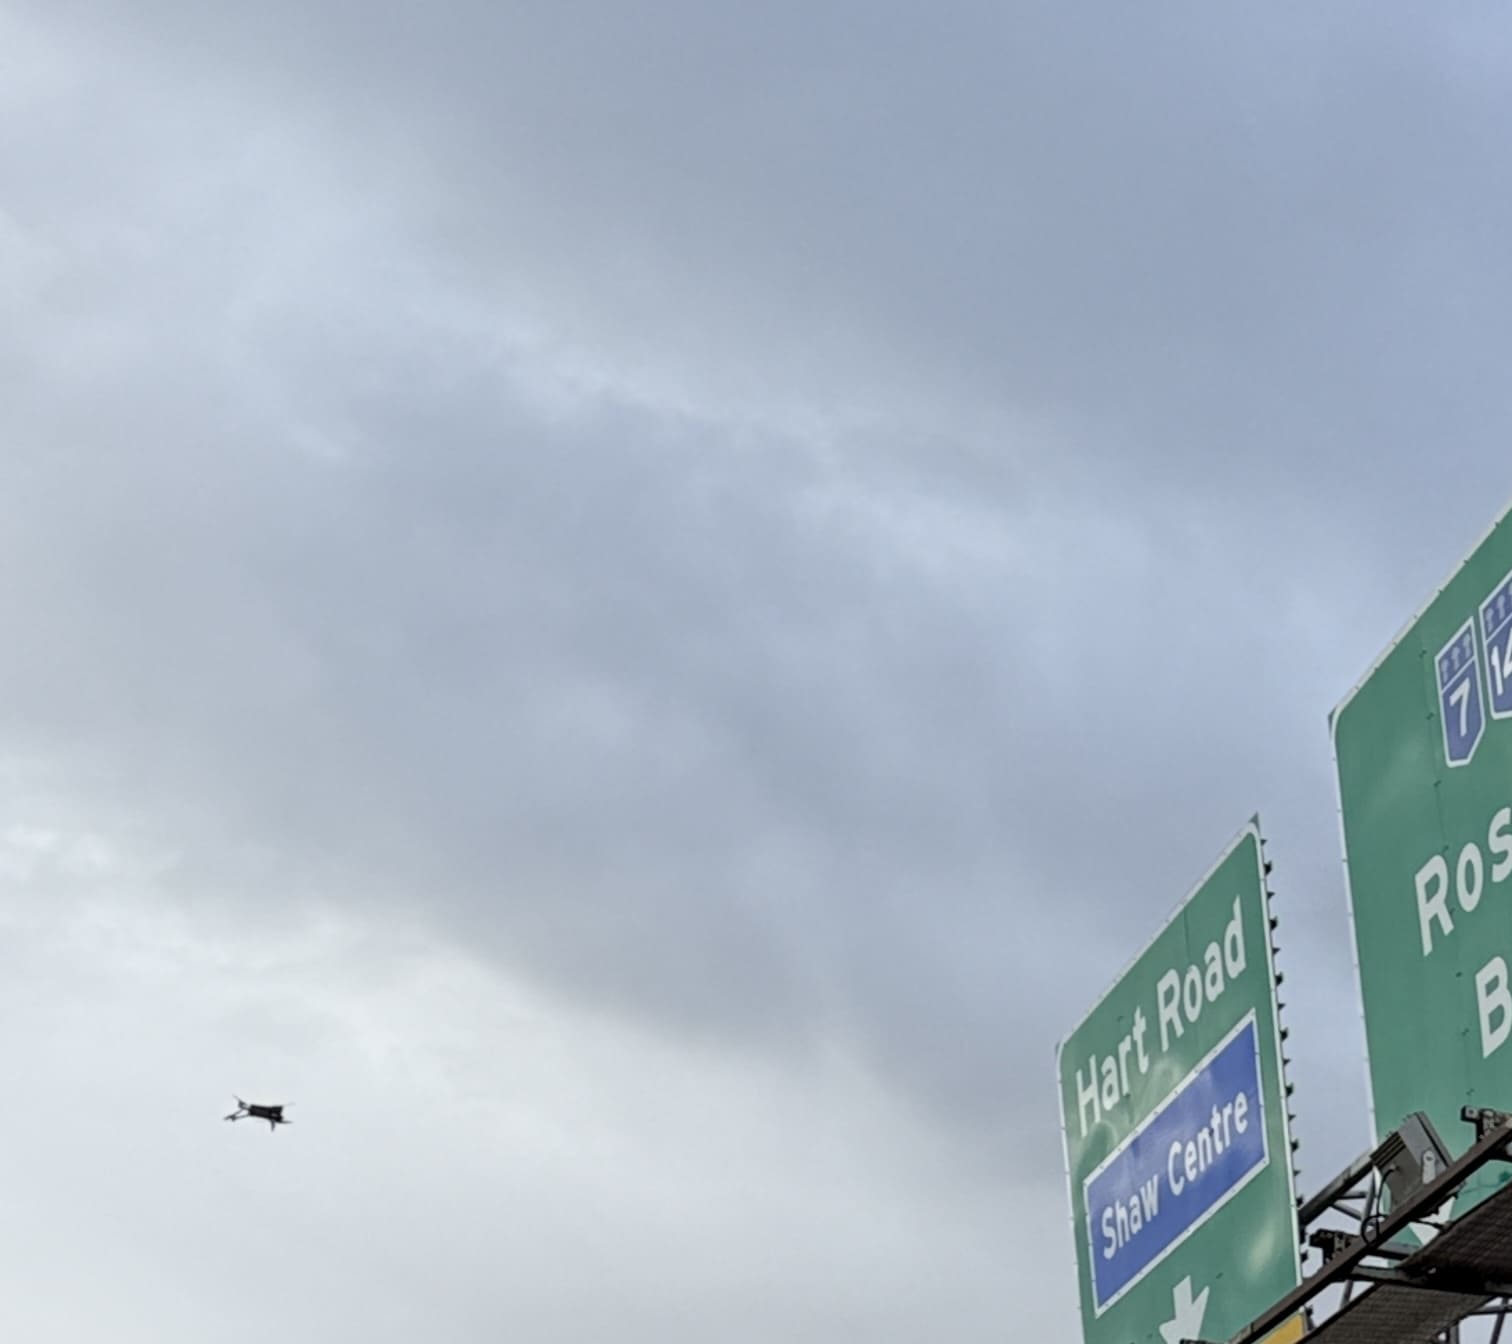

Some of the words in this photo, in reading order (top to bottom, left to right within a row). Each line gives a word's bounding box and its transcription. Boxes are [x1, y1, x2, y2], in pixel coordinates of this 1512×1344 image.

[1449, 677, 1471, 737] 7
[1075, 1007, 1150, 1138] Hart
[1156, 895, 1247, 1054] Road
[1101, 1173, 1160, 1260] Shaw
[1166, 1091, 1249, 1196] Centre
